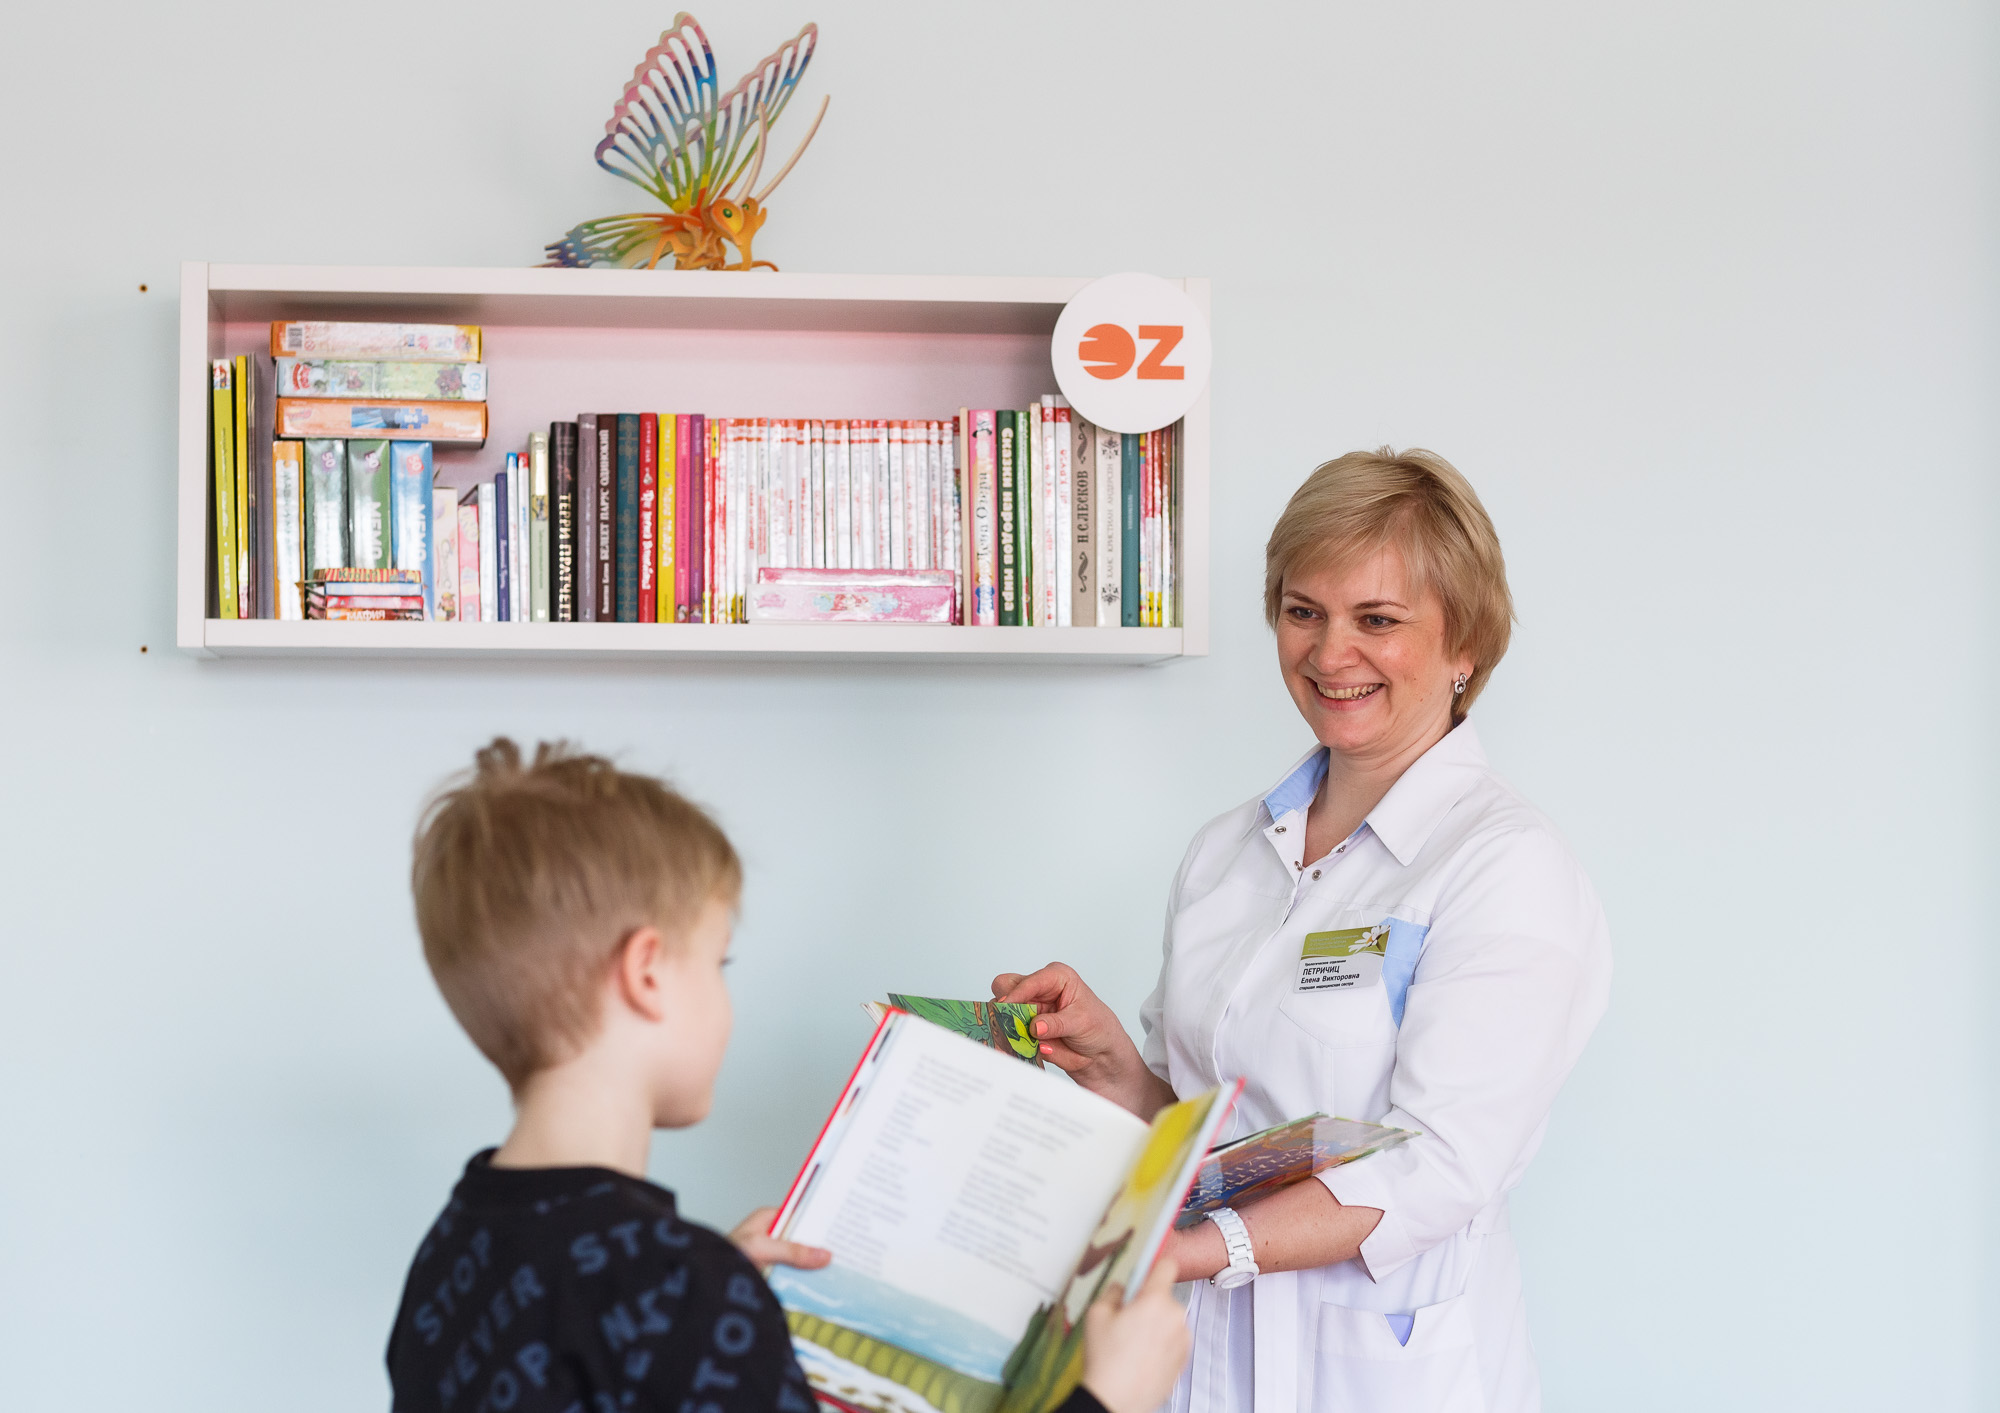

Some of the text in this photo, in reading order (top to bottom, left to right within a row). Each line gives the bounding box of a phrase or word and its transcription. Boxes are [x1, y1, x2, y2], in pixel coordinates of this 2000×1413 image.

[408, 455, 423, 470] 50
[598, 429, 610, 486] ОДИНОКИЙ
[600, 488, 610, 521] ПАРУС
[1001, 427, 1016, 612] Сказки народов мира
[1105, 463, 1115, 579] ХАНС КРИСТИАН АНДЕРСЕН
[415, 504, 427, 562] MEMO
[558, 492, 573, 621] ТЕРРИ ПРАТЧЕТТ
[600, 523, 610, 560] БЕЛЕЕТ
[347, 609, 386, 621] МАФИЯ
[1301, 972, 1360, 984] Елена Викторовна
[1303, 965, 1340, 976] ПЕТРИЧИЦ
[413, 1225, 492, 1346] STOP
